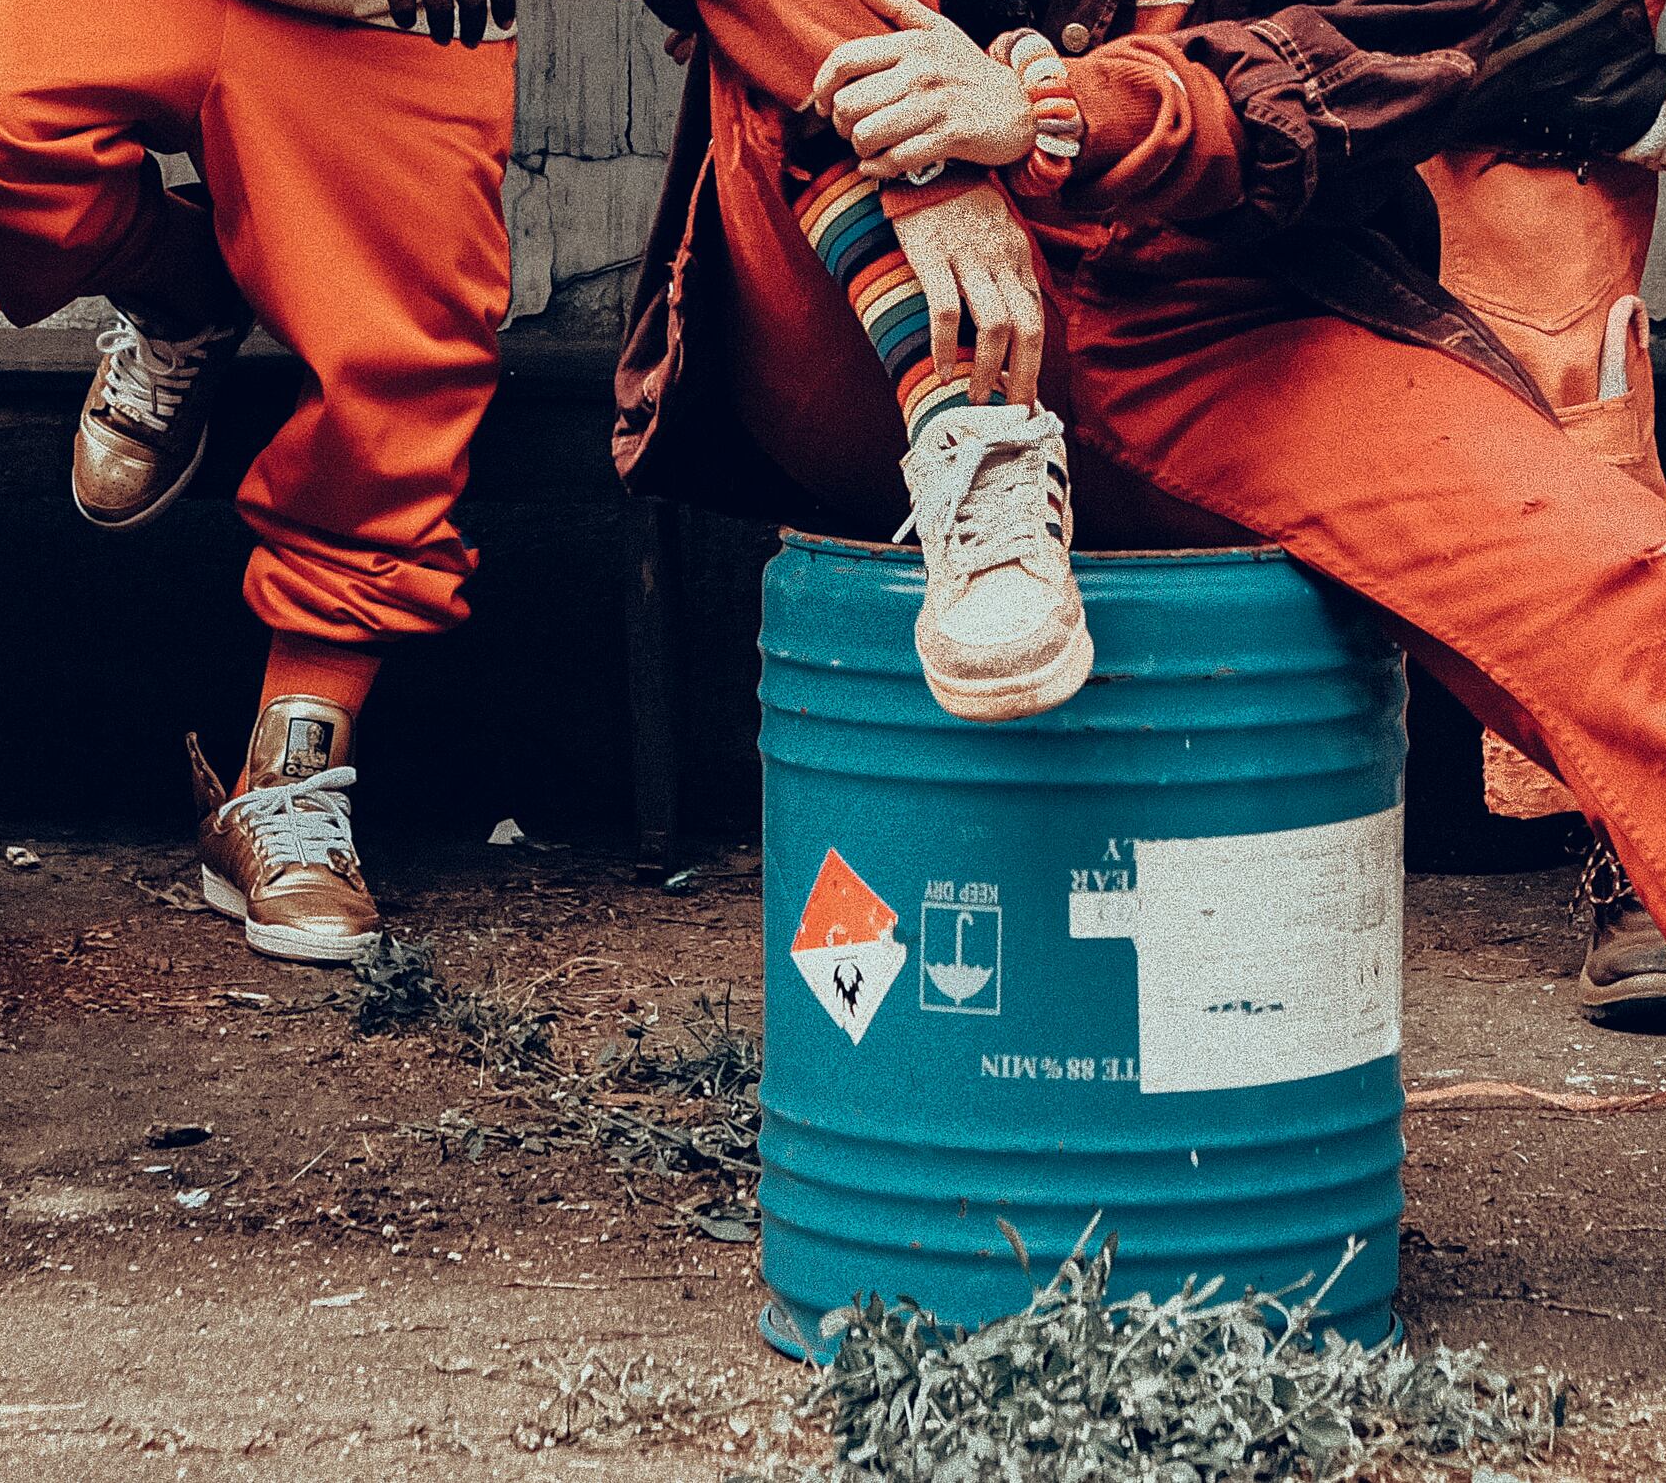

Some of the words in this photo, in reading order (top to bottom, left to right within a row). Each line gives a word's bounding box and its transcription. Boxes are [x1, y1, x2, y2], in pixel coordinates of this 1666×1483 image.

[925, 879, 954, 902] DRY
[1070, 869, 1131, 892] EAR
[958, 882, 999, 905] KEEP
[1101, 1057, 1140, 1082] TE
